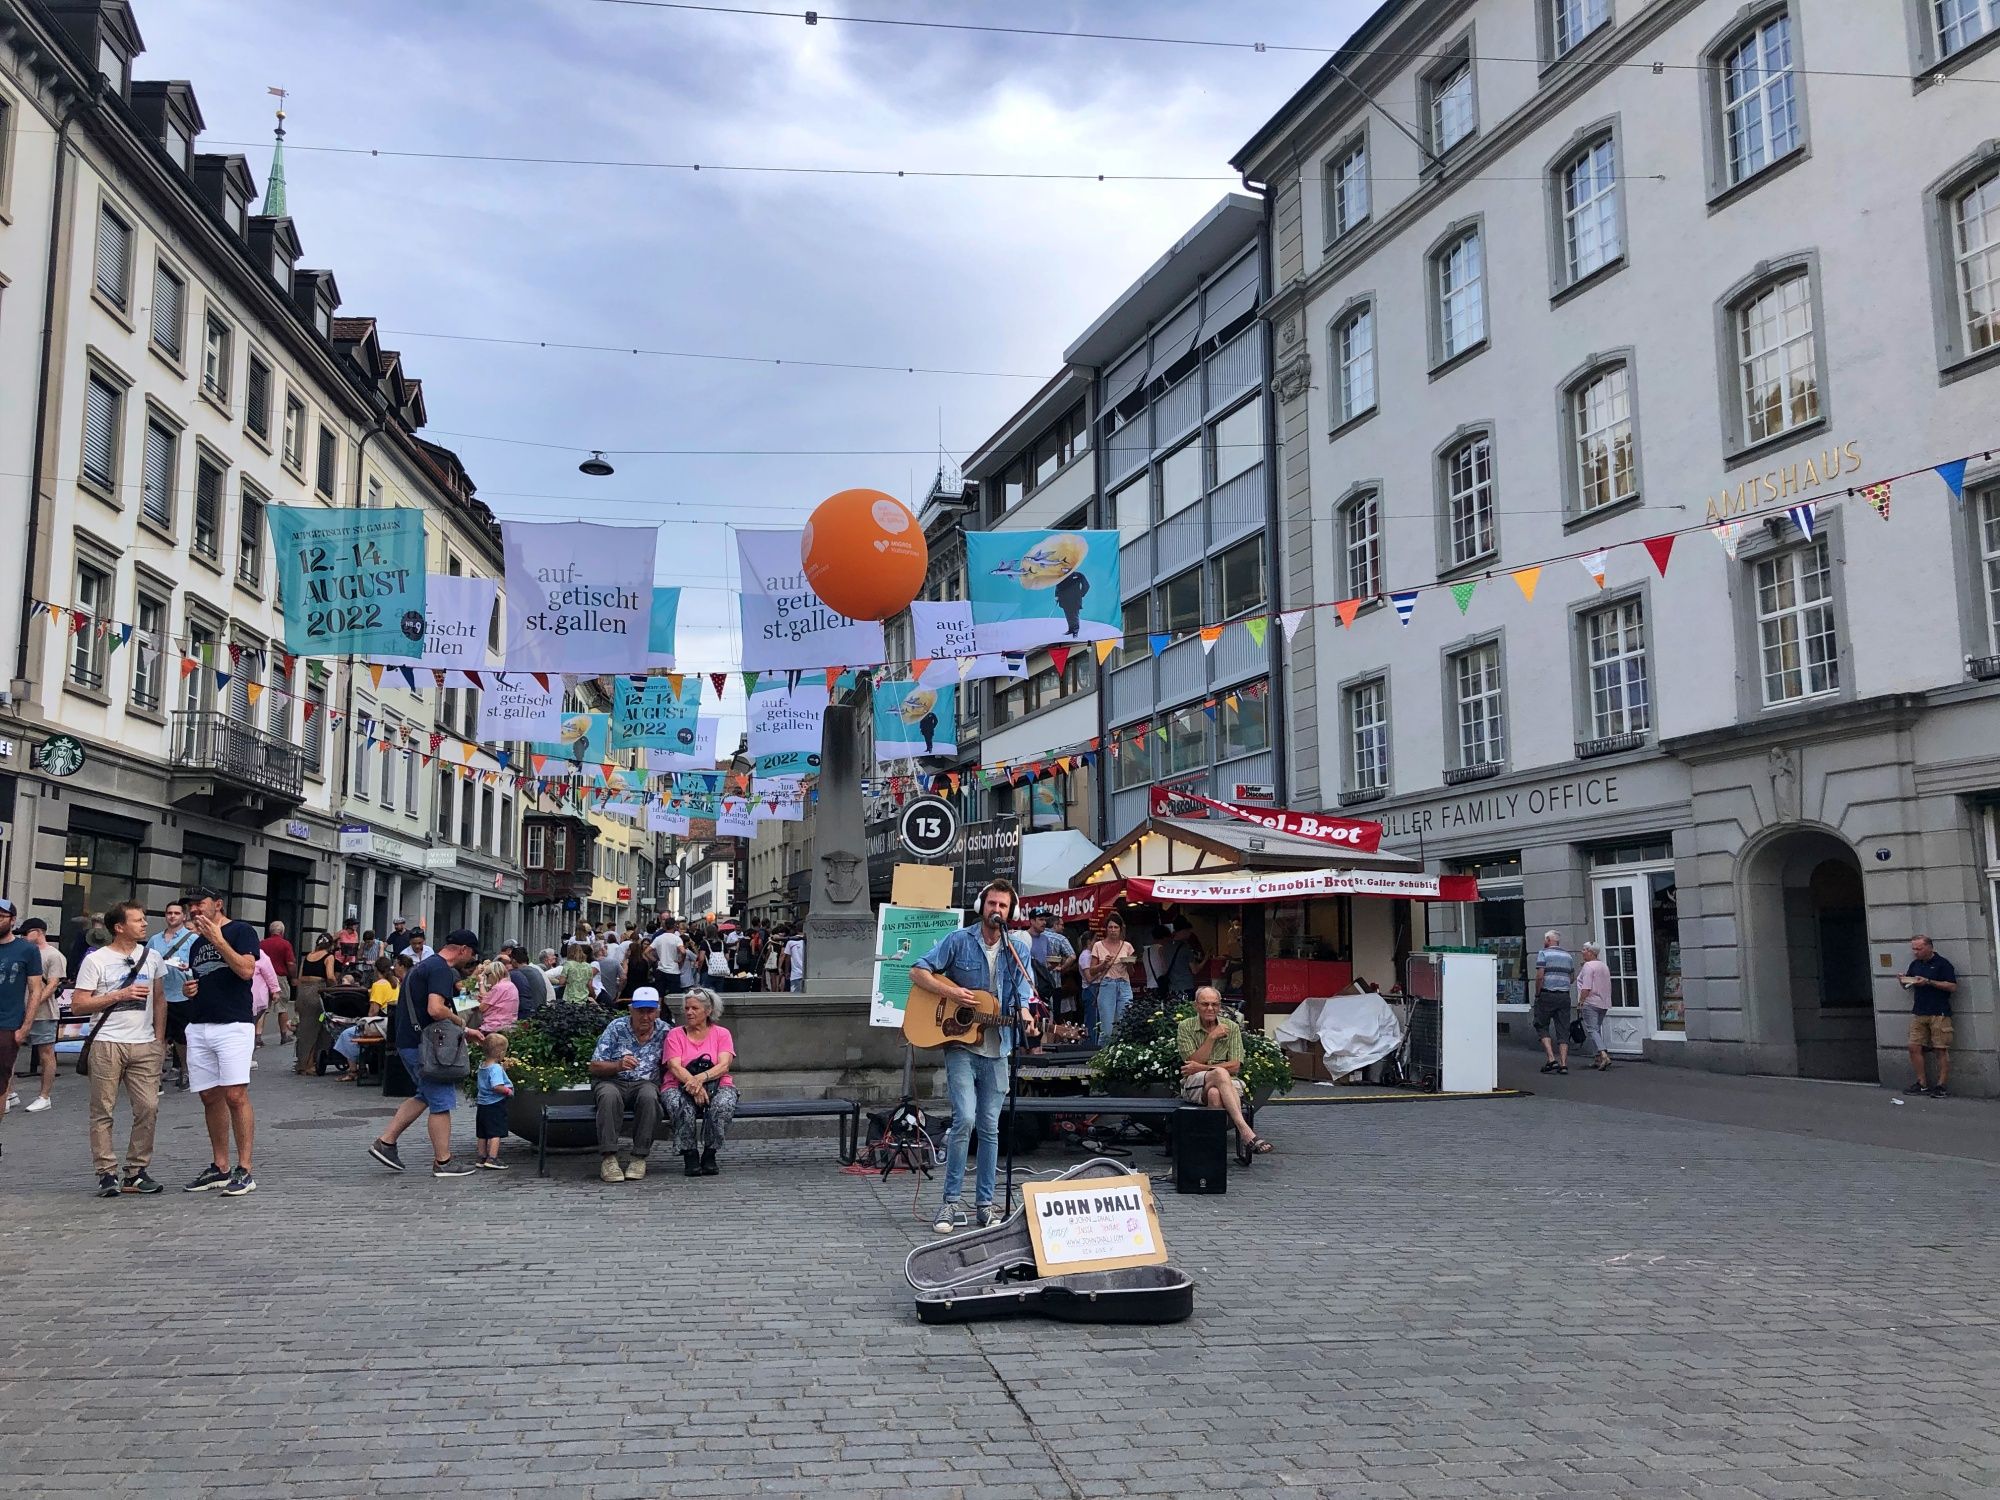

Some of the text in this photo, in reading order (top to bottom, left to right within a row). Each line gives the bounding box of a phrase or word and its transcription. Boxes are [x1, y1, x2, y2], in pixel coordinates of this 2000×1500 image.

[1706, 440, 1862, 524] AMTSHAUS
[537, 562, 583, 584] auf-
[302, 568, 410, 606] AUGUST
[548, 585, 639, 612] getischt
[307, 603, 383, 637] 2022
[500, 693, 553, 706] getischt
[761, 697, 789, 708] auf-
[622, 706, 688, 721] AUGUST
[767, 708, 820, 721] getischt
[622, 721, 667, 739] 2022
[763, 752, 799, 769] 2022
[1378, 777, 1619, 838] ÜLLER FAMILY OFFICE
[916, 817, 942, 839] 13
[968, 830, 993, 850] asian
[995, 825, 1019, 848] food
[1258, 876, 1353, 893] Chnobli-Brot
[1399, 879, 1437, 891] Schüblig
[1042, 1194, 1141, 1218] JOHN DHALI
